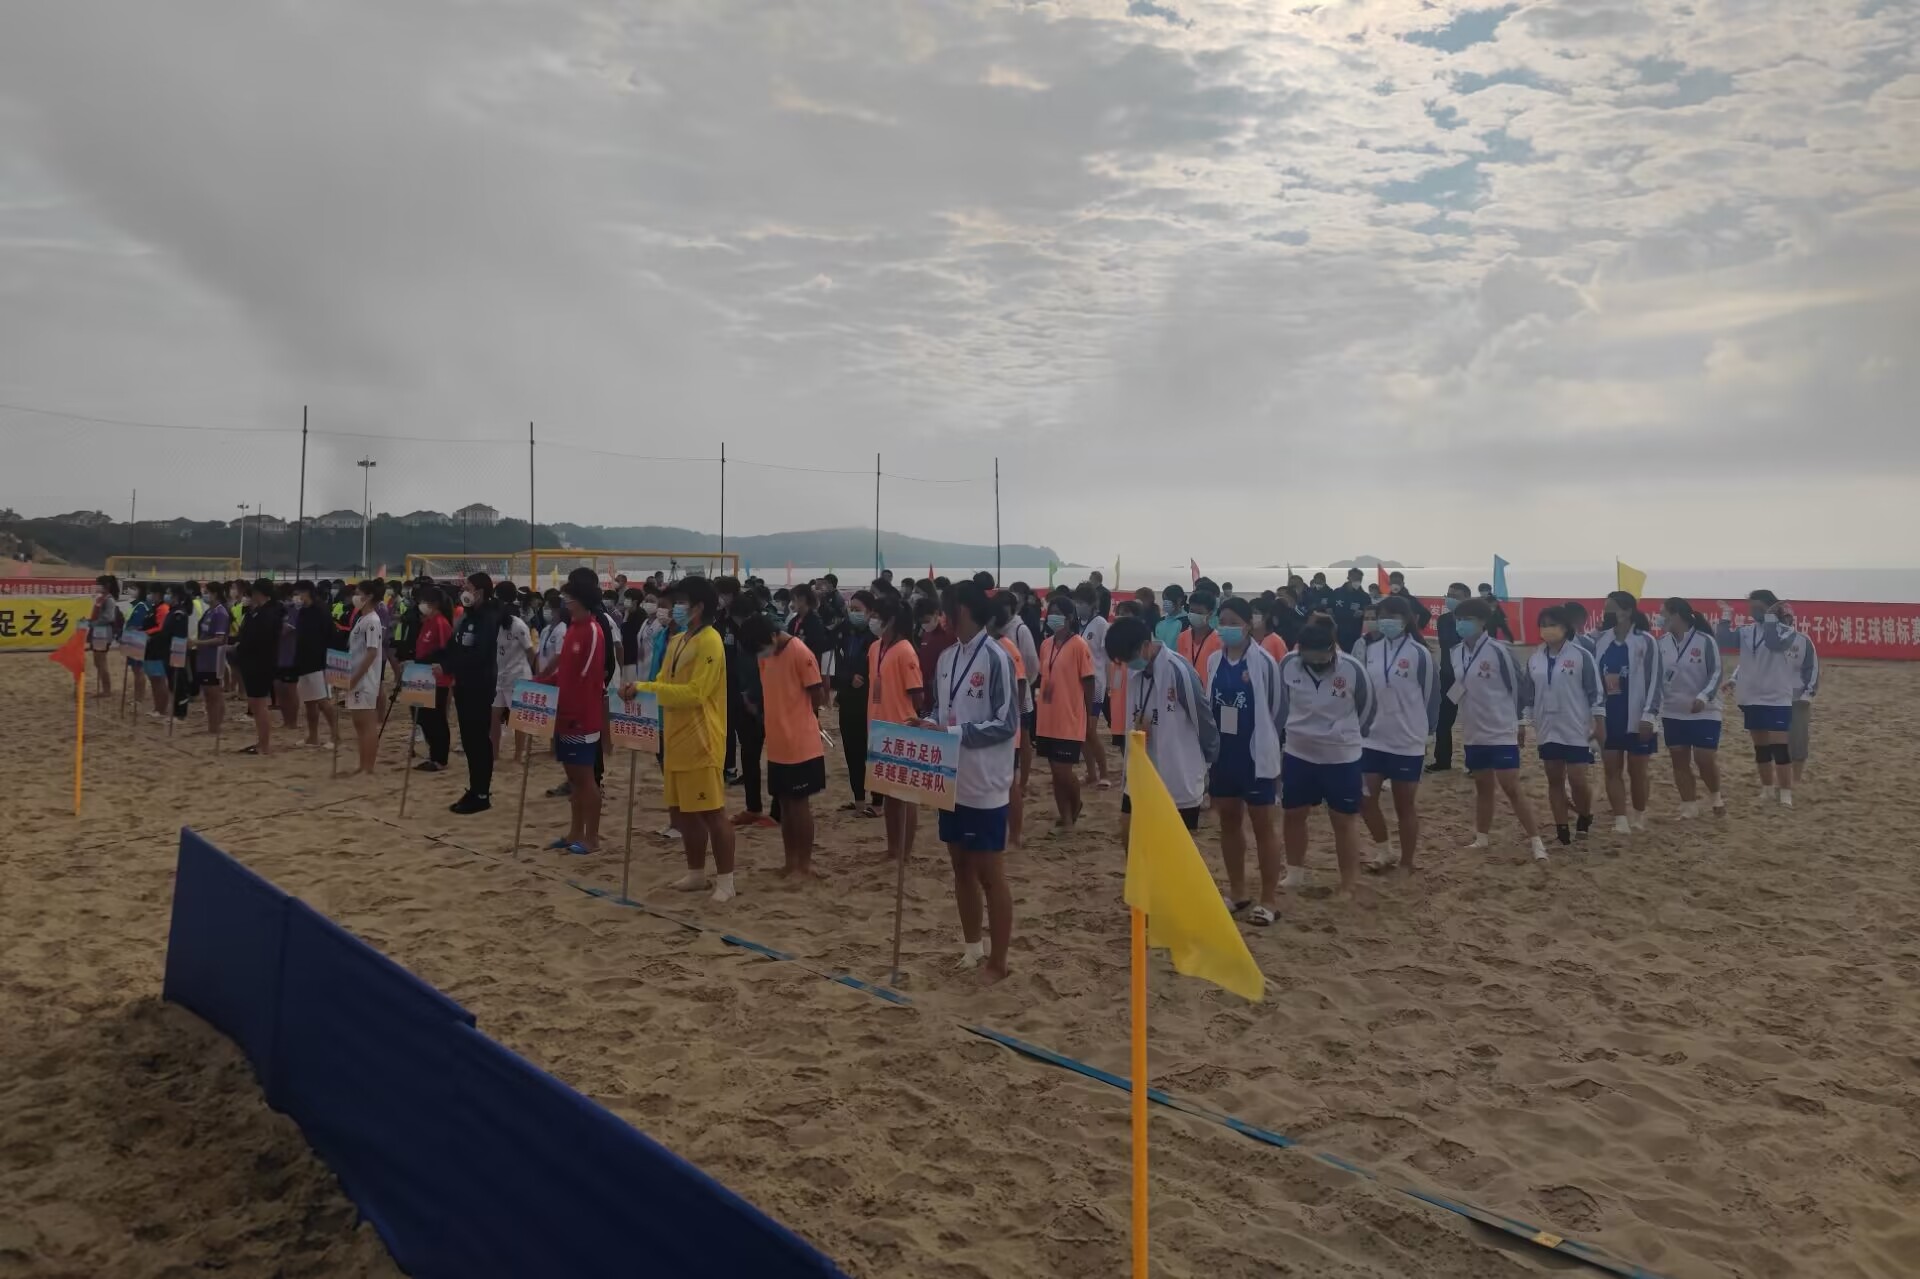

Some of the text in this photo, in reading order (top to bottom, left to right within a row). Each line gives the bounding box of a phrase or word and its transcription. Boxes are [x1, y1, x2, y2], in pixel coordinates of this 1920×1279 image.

[0, 608, 69, 637] 足之乡
[1793, 615, 1920, 646] 女子沙滩足球锦标赛
[1214, 687, 1248, 709] 太原
[881, 736, 943, 765] 太原市足协
[873, 760, 947, 794] 卓越星足球队
